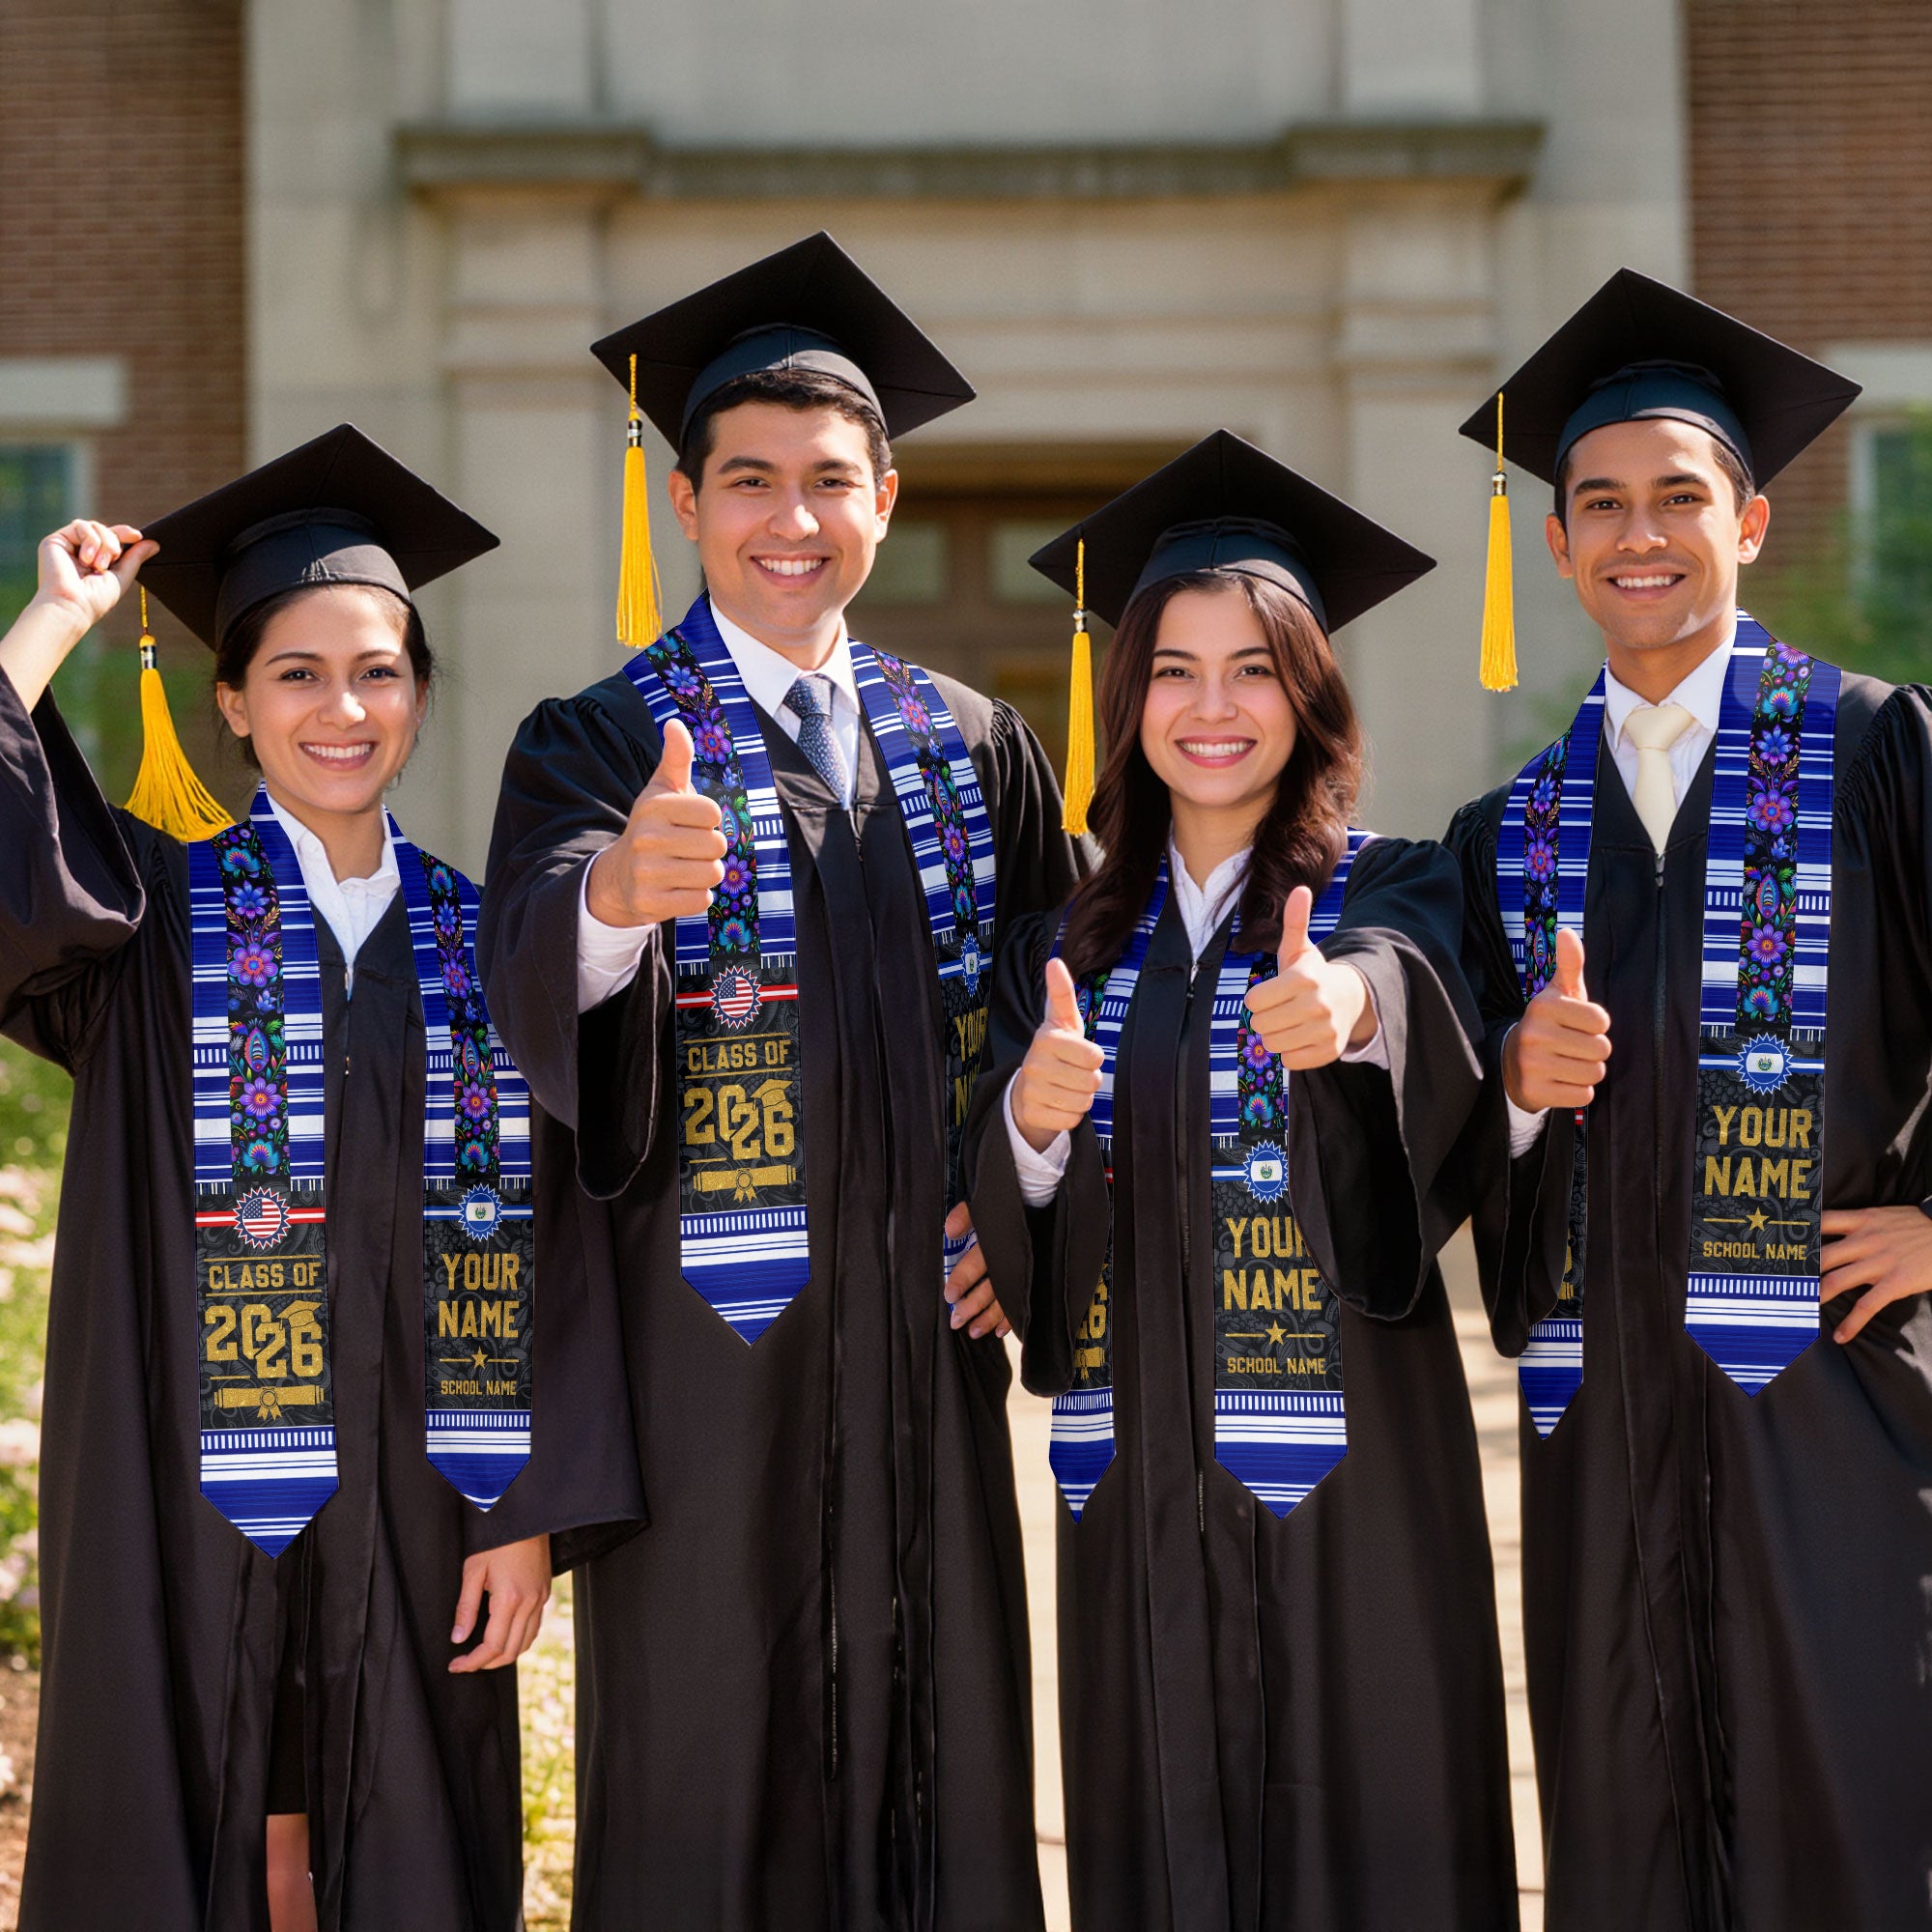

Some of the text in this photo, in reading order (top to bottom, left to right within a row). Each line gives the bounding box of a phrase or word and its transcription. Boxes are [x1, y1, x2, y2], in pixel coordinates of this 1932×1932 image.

[688, 1039, 791, 1072] CLASS OF
[684, 1084, 795, 1160] 2026
[1713, 1106, 1812, 1149] YOUR
[1704, 1156, 1812, 1199] NAME
[1702, 1241, 1807, 1261] SCHOOL NAME
[209, 1262, 322, 1290] CLASS OF
[441, 1253, 520, 1291] YOUR
[1223, 1268, 1321, 1310] NAME
[439, 1300, 520, 1338] NAME
[205, 1303, 323, 1378] 2026
[1227, 1357, 1326, 1375] SCHOOL NAME
[440, 1379, 517, 1396] SCHOOL NAME
